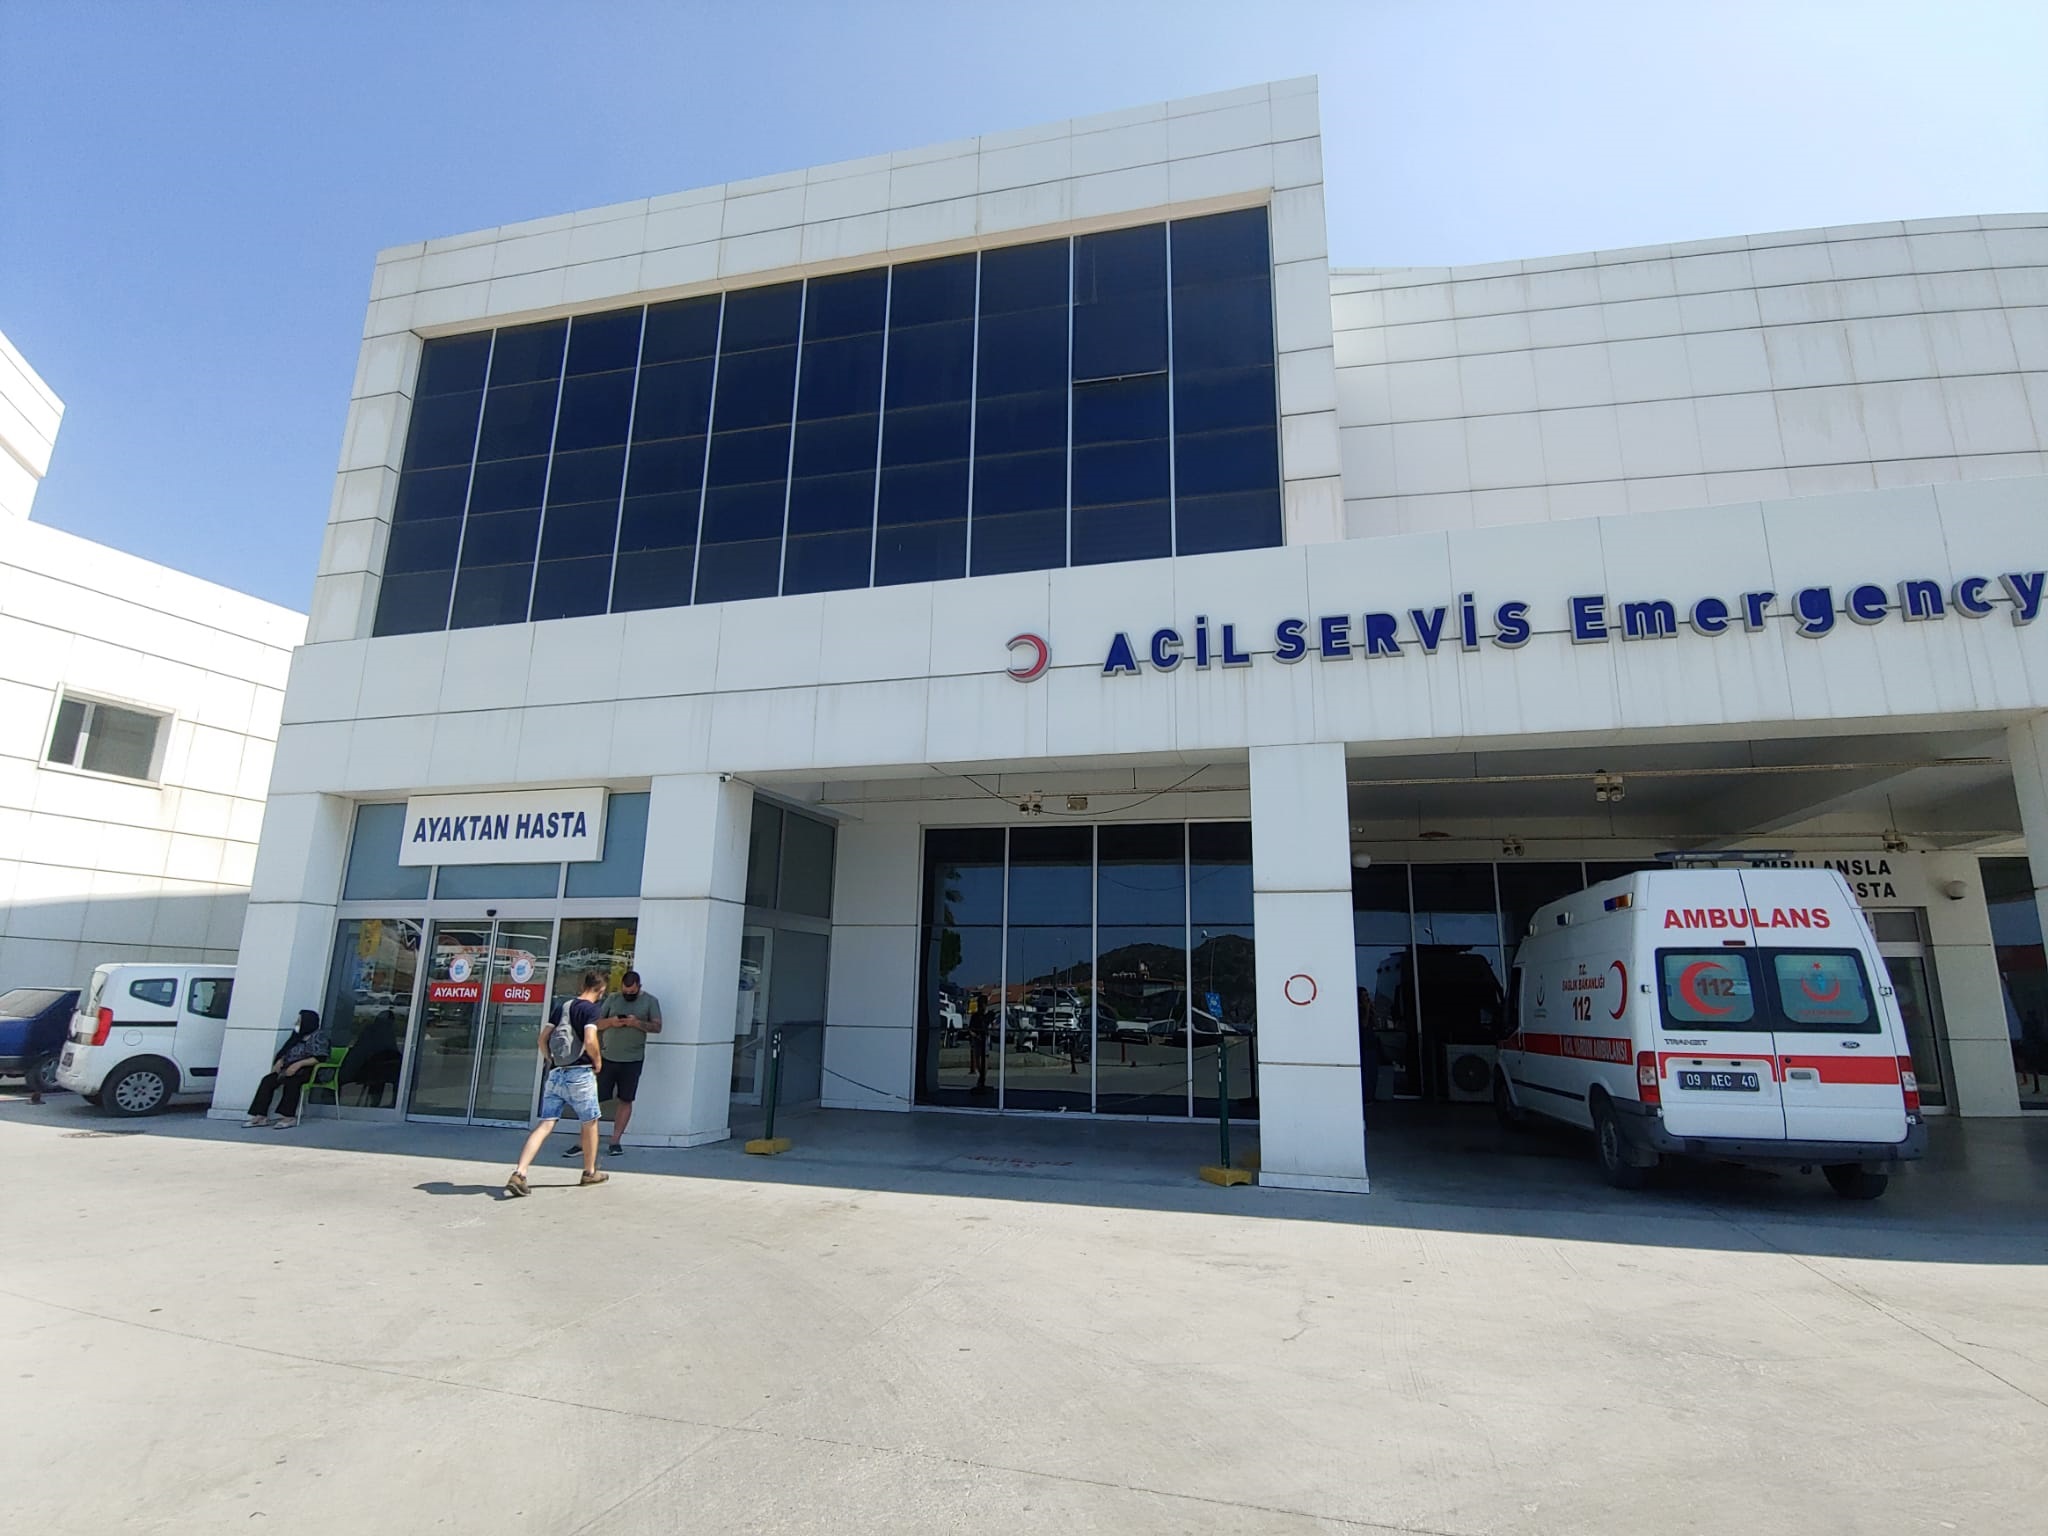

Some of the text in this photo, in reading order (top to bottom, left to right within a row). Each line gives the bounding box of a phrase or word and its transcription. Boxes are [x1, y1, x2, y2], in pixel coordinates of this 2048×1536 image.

[1101, 571, 2047, 677] ACİL SERVİS Emergency
[412, 811, 587, 843] AYAKTAN HASTA
[1846, 882, 1897, 898] STA
[1664, 908, 1831, 929] AMBULANS
[434, 987, 478, 998] AYAKTAN
[504, 986, 531, 1001] GİRİŞ
[1697, 979, 1735, 996] 112
[1572, 996, 1591, 1021] 112
[1686, 1073, 1756, 1088] 09 AEC 40
